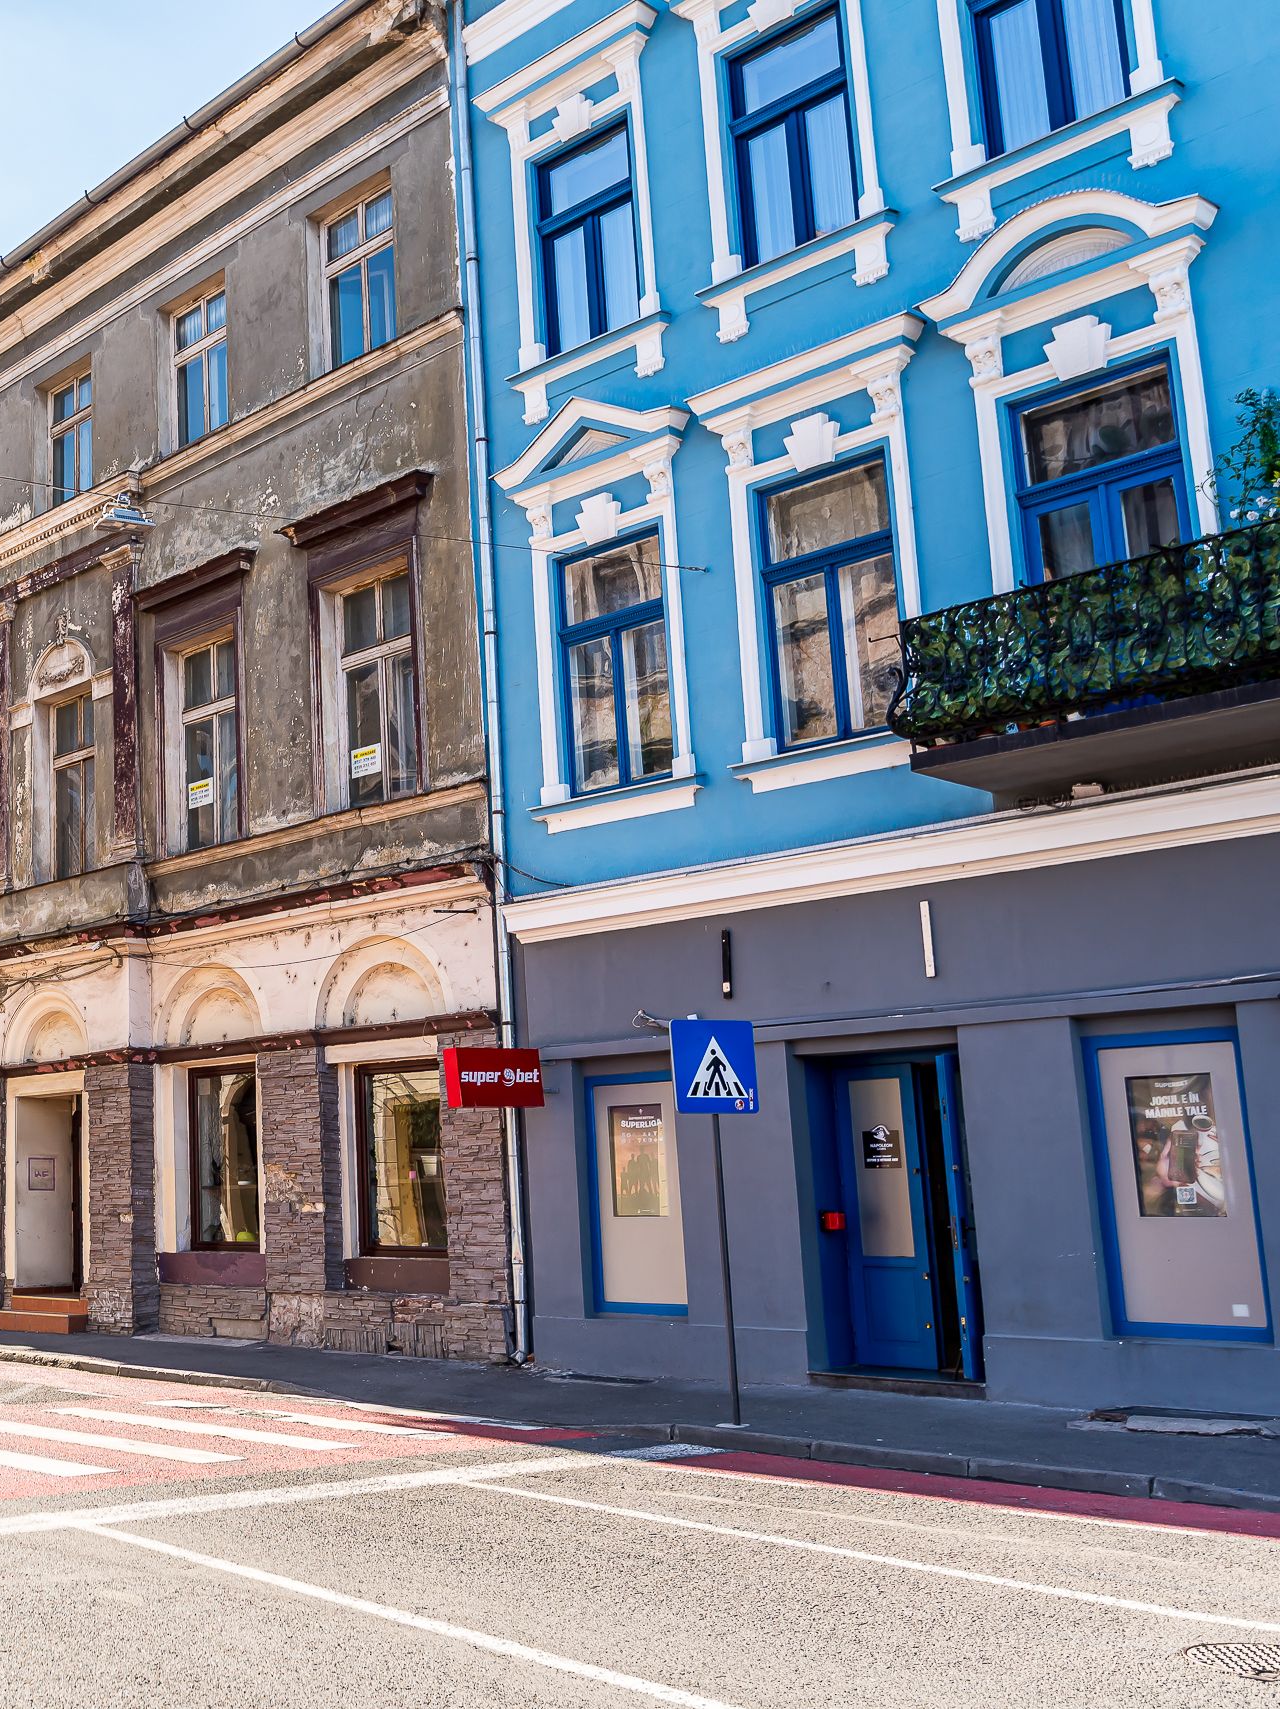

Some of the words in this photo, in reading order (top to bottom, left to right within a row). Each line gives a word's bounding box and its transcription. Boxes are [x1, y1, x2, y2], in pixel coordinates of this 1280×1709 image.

[1150, 1095, 1180, 1107] JOCUL
[1181, 1094, 1188, 1104] E
[1184, 1105, 1208, 1116] TALE
[620, 1118, 663, 1129] SUPERLIGA
